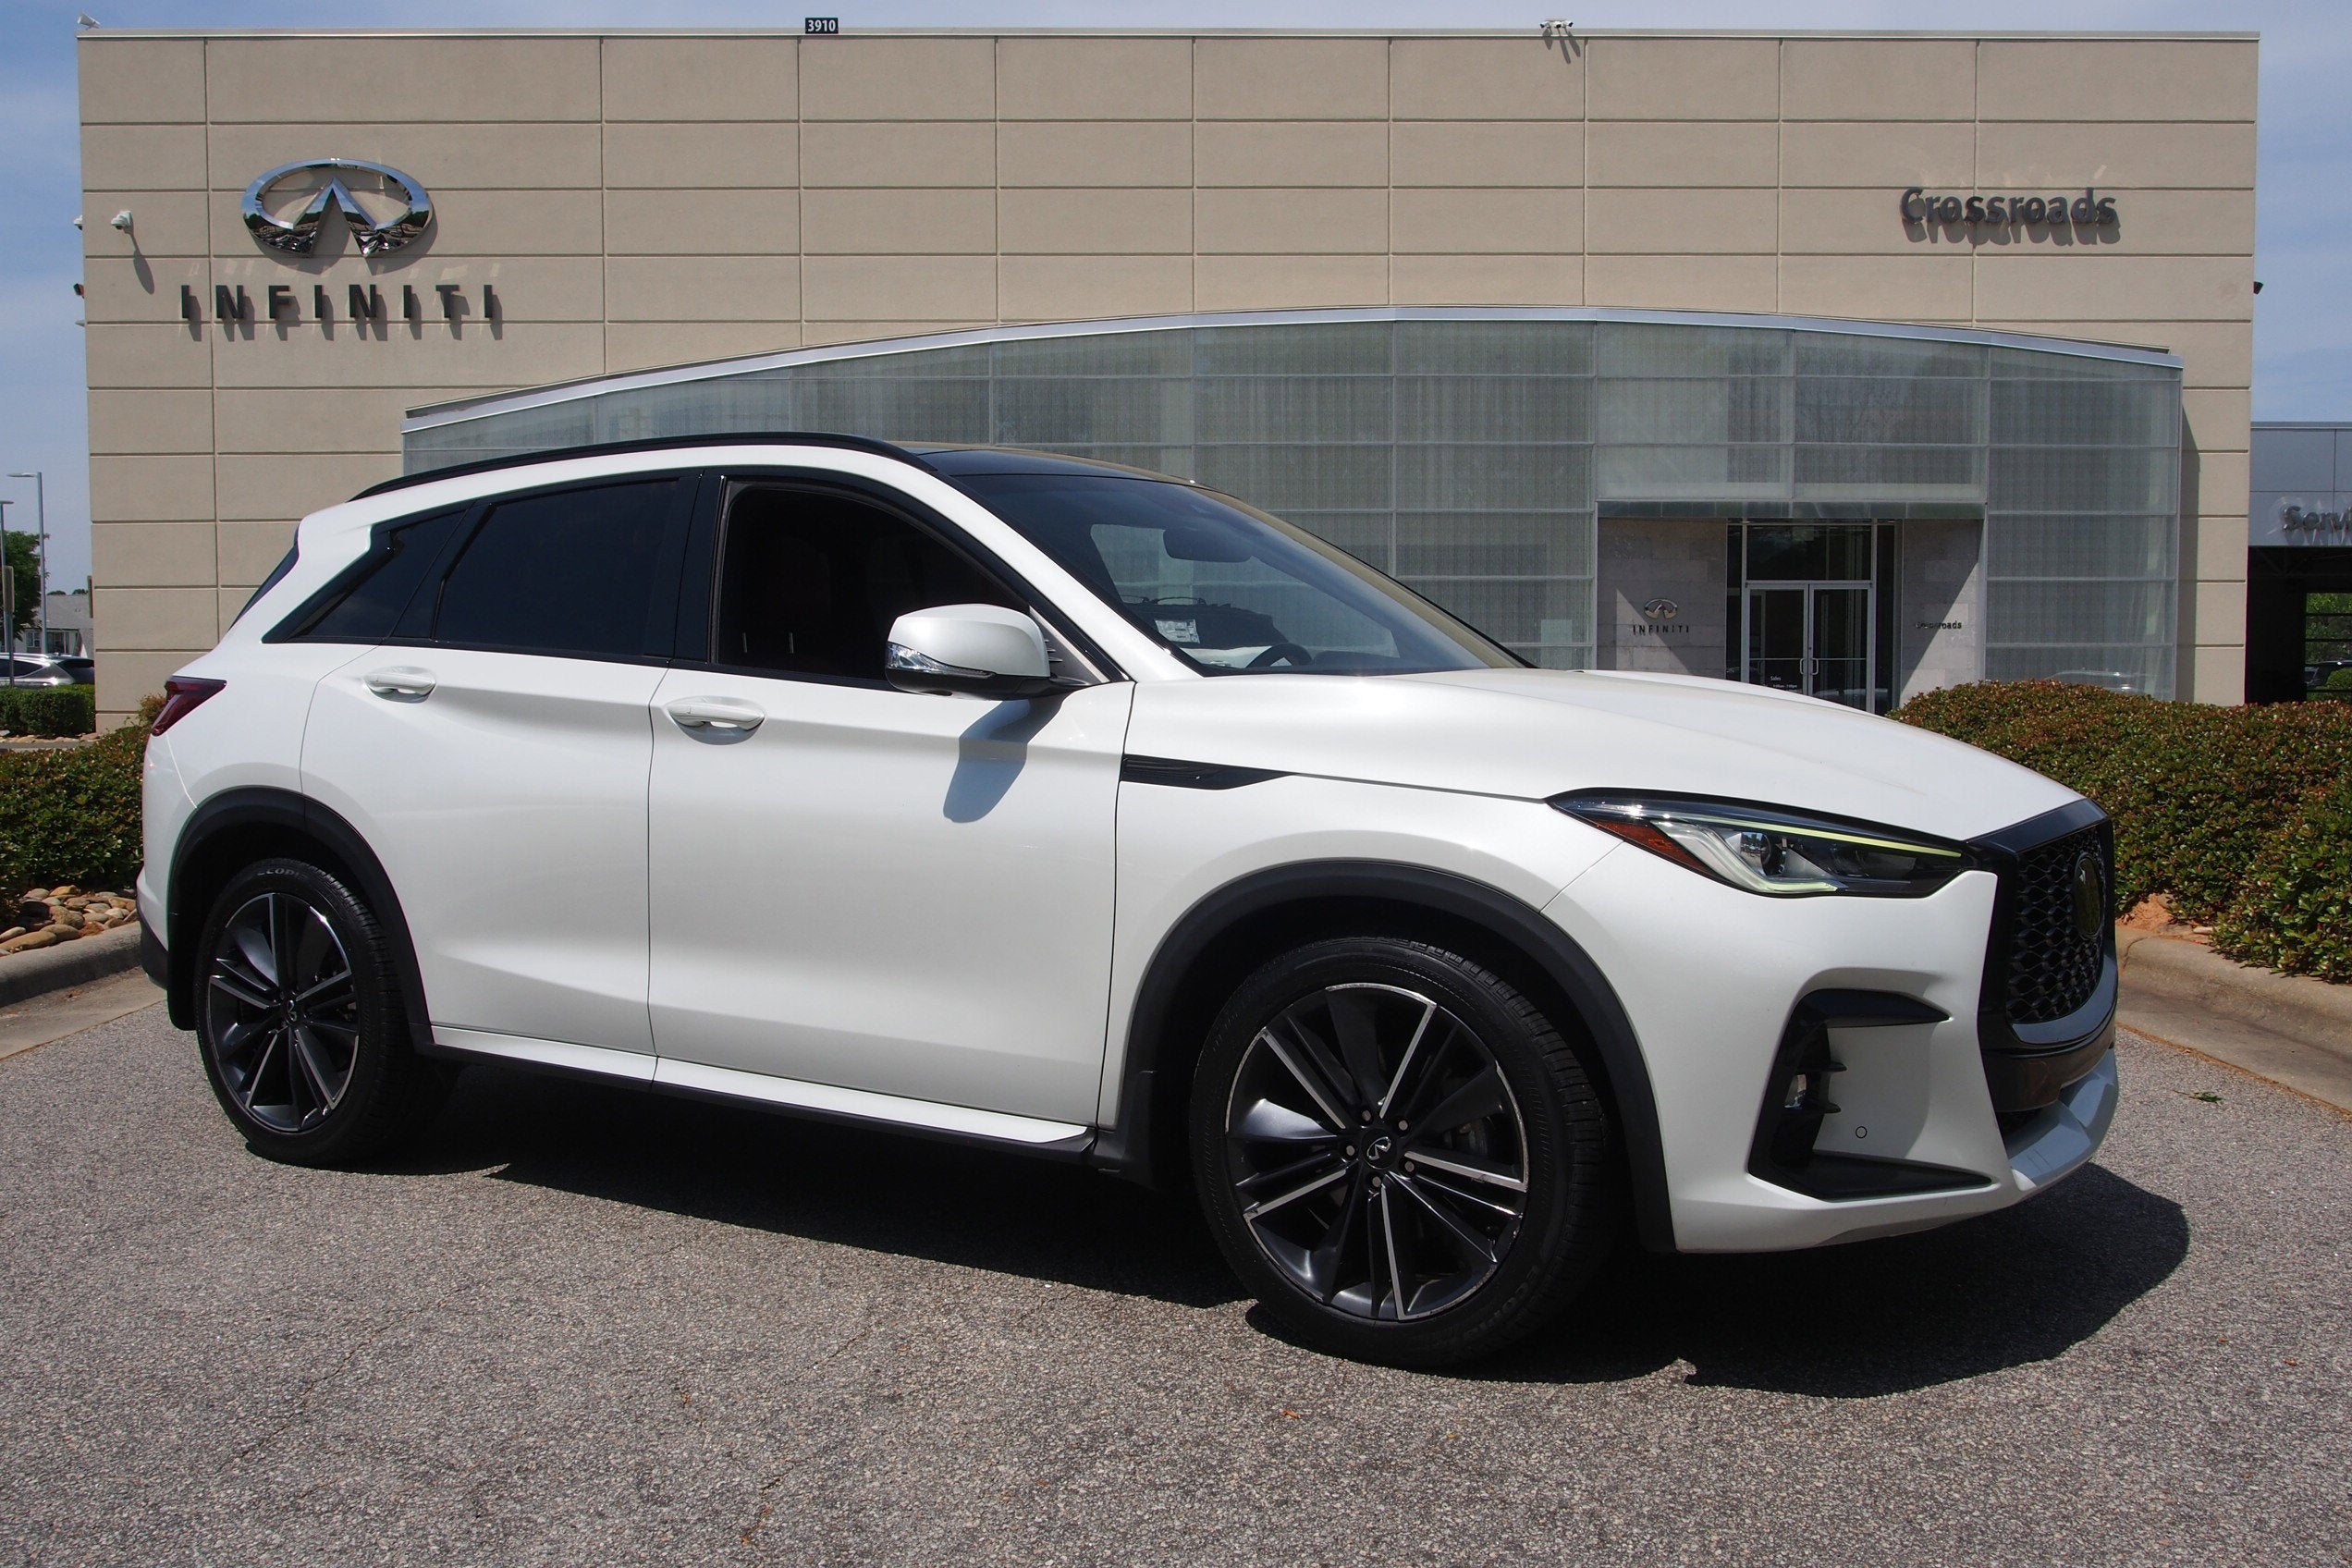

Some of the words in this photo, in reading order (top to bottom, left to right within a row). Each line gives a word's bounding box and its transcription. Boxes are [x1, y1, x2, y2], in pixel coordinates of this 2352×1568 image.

[807, 19, 837, 32] 3910
[1899, 186, 2117, 224] Crossroads
[180, 284, 493, 319] INFINITI
[1633, 624, 1689, 635] INFINITI
